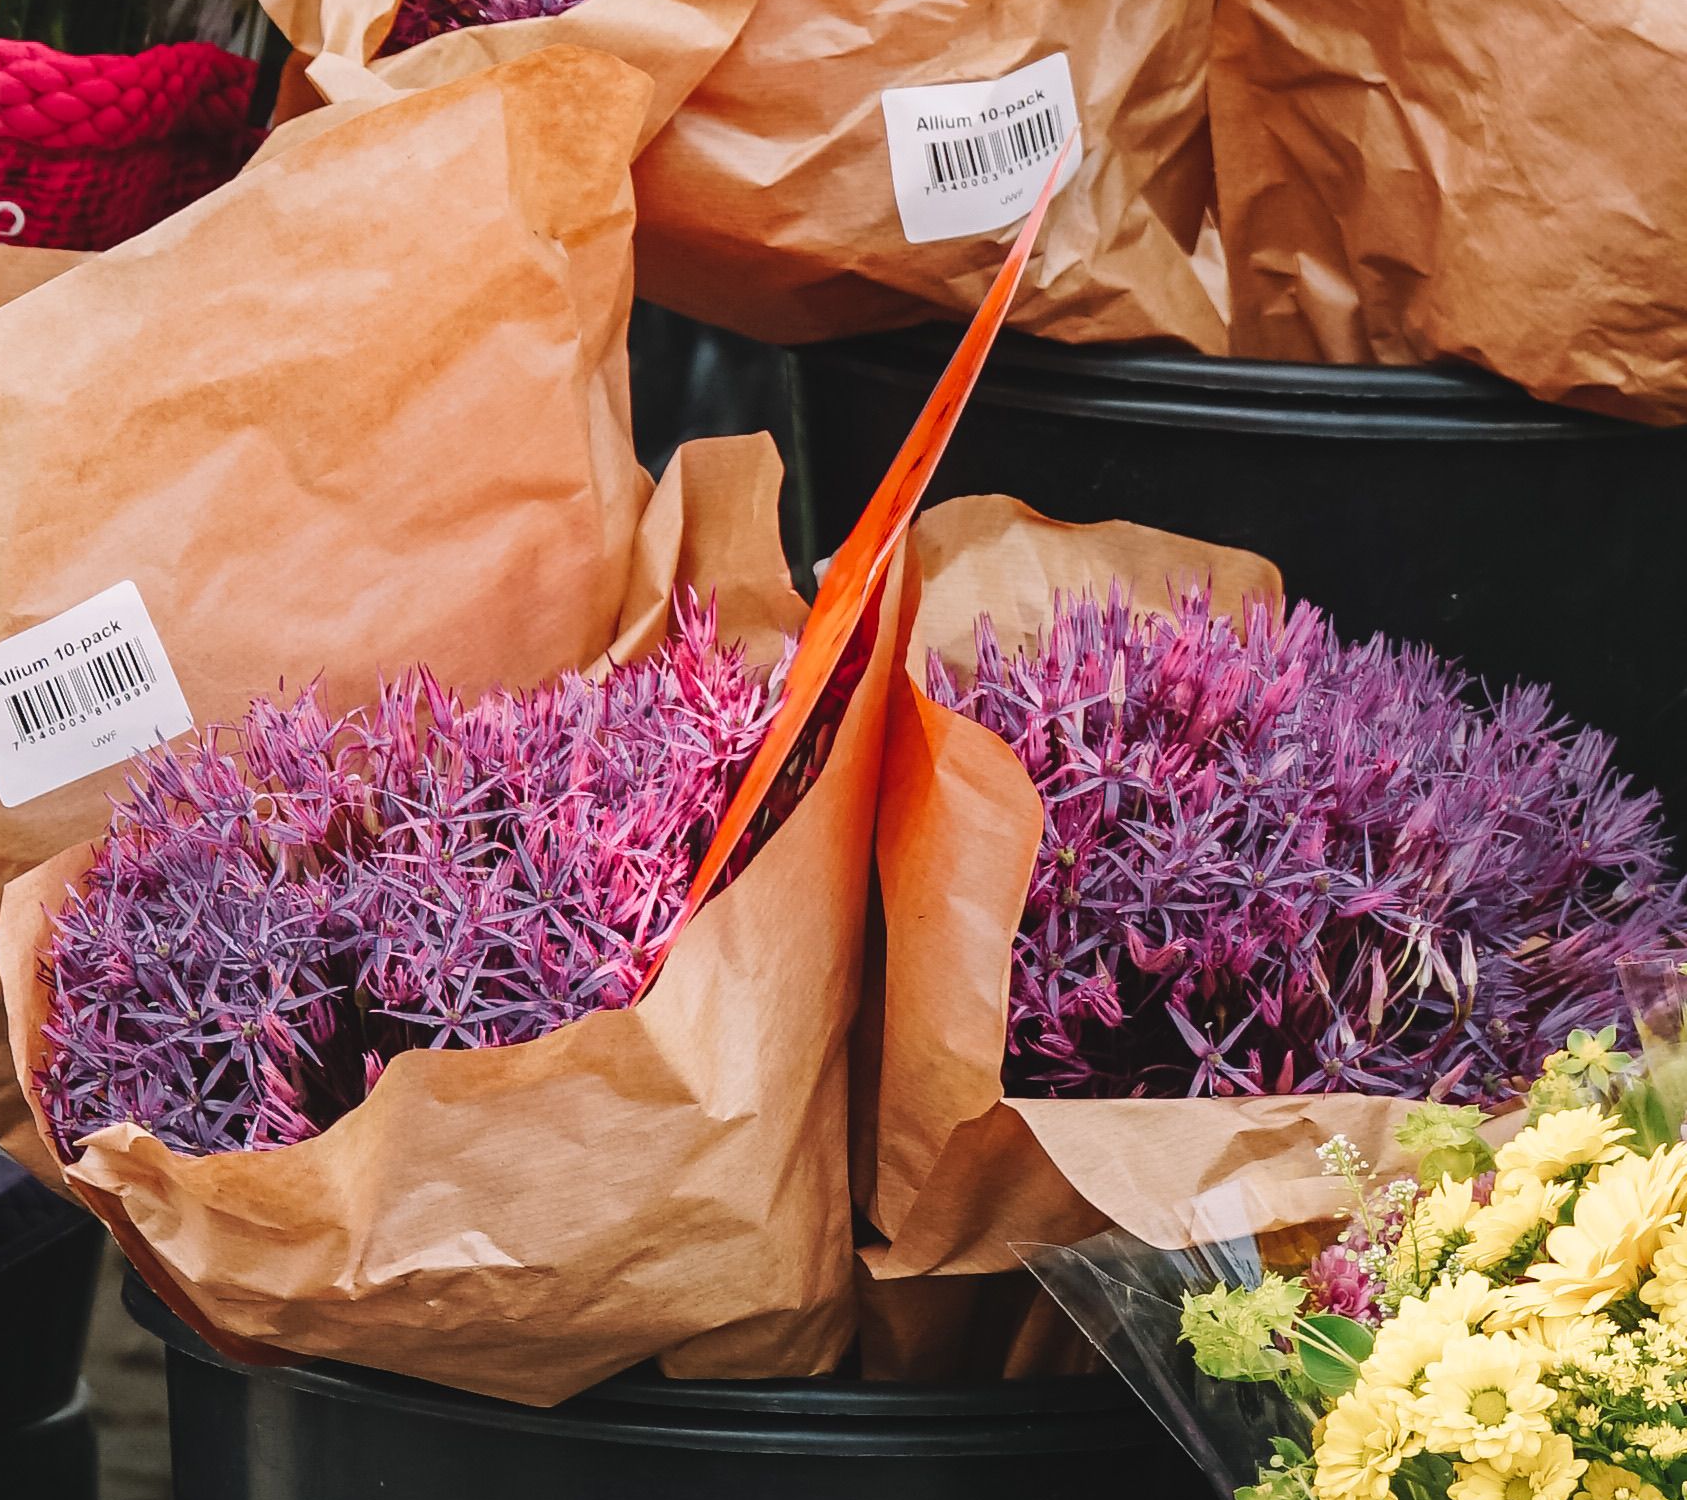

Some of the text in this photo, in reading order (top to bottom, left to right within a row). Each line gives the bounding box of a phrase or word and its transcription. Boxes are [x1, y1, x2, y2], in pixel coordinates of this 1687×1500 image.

[915, 88, 1046, 133] Allium 10-pack
[53, 619, 123, 662] 10-pack
